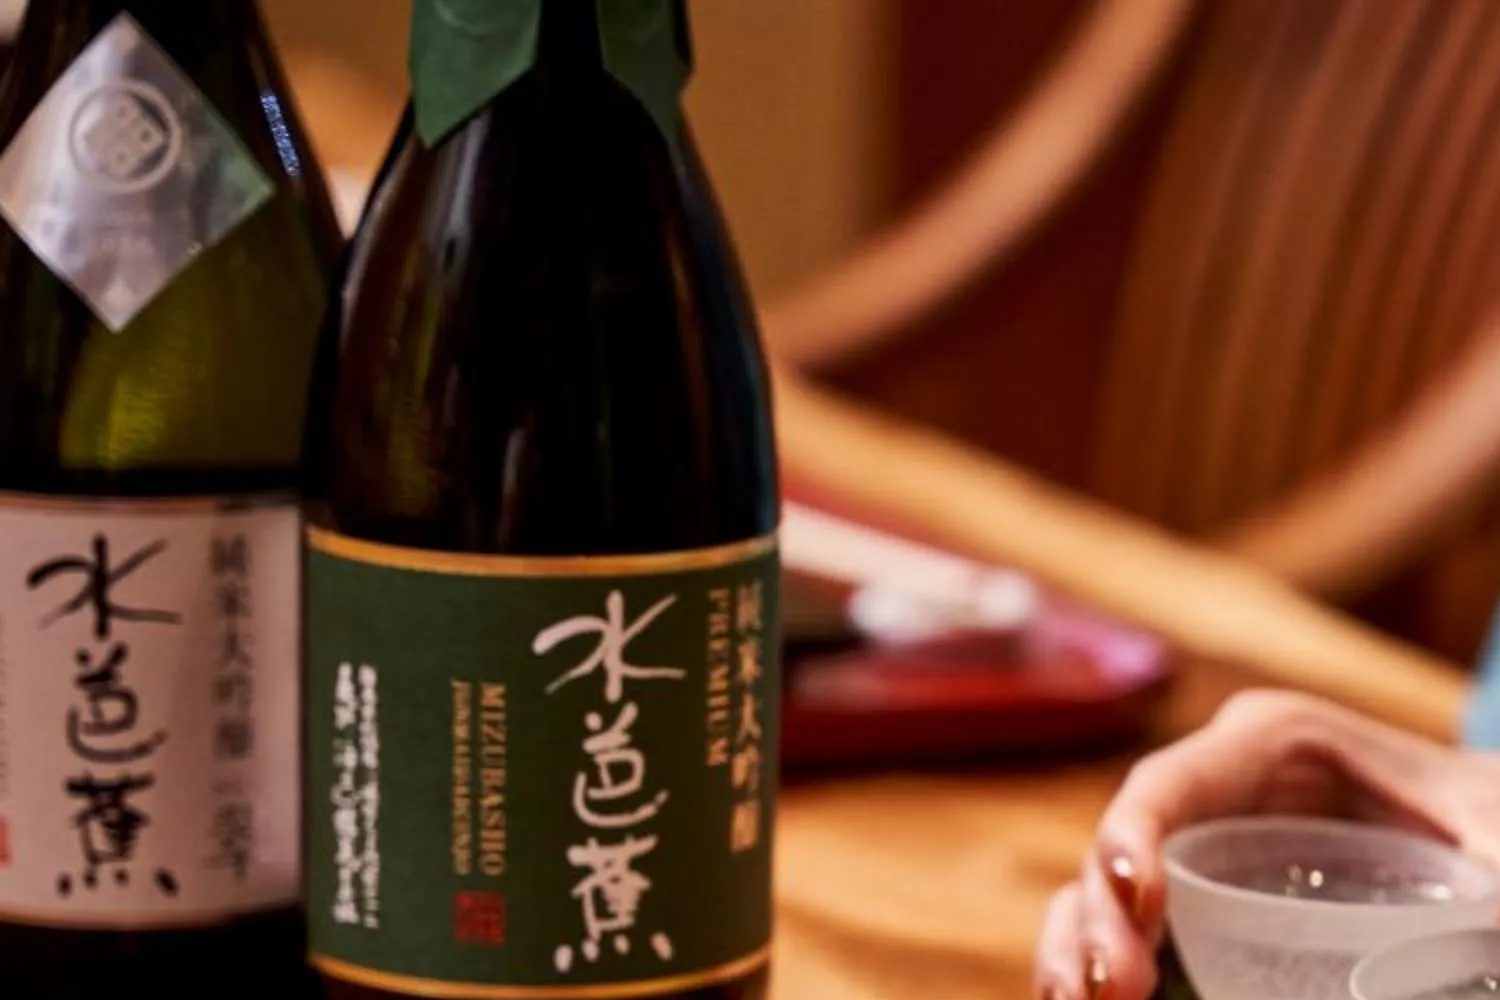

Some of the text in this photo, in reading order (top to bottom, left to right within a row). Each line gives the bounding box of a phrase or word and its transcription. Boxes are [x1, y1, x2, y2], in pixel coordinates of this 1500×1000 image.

[27, 534, 183, 897] 水芭蕉
[480, 680, 506, 877] MIZUBASHO
[532, 589, 687, 972] 水芭蕉
